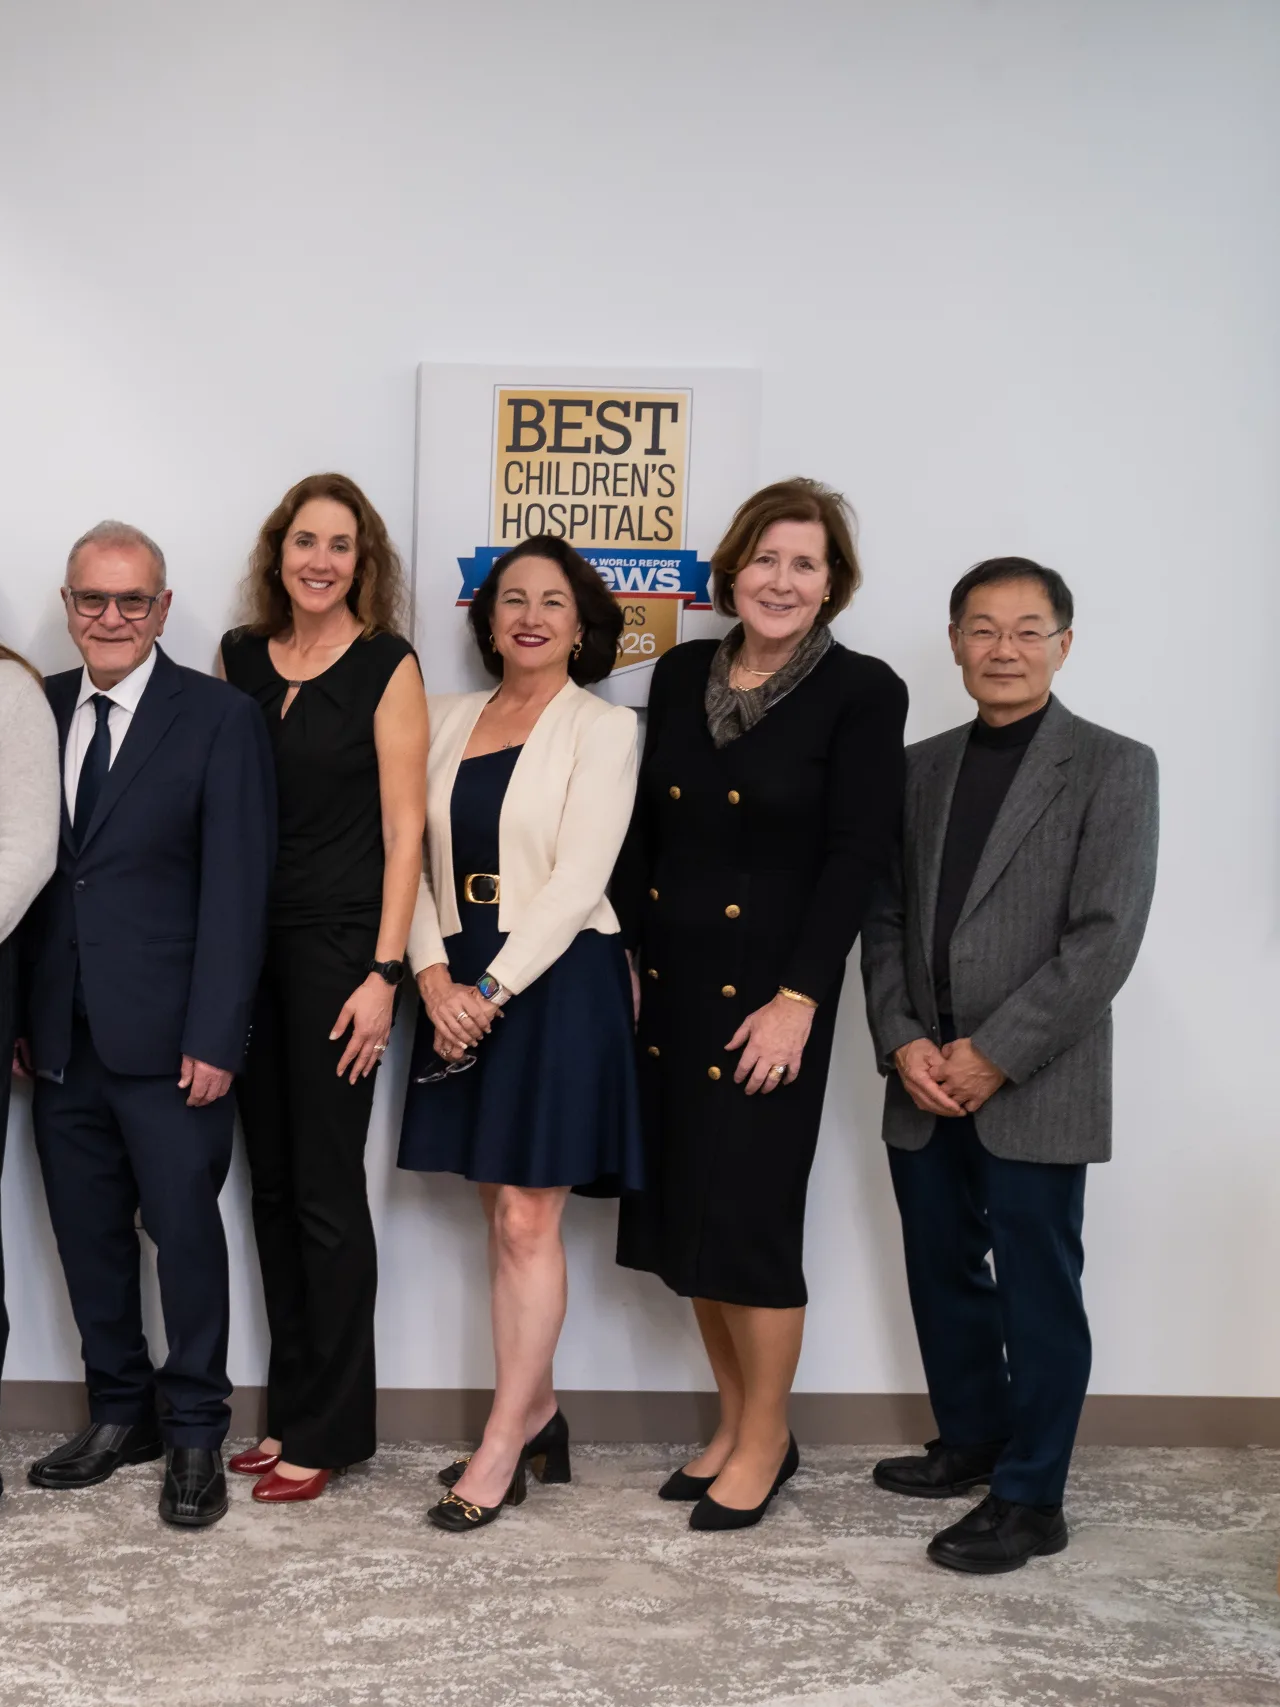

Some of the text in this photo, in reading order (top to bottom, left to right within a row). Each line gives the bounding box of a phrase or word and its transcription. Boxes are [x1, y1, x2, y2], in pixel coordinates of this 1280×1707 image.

[505, 398, 679, 456] BEST
[504, 460, 676, 498] CHILDREN’S
[502, 503, 674, 542] HOSPITALS
[599, 558, 637, 567] WORLD
[638, 559, 682, 568] REPORT
[595, 566, 681, 593] ews
[622, 605, 646, 626] CS
